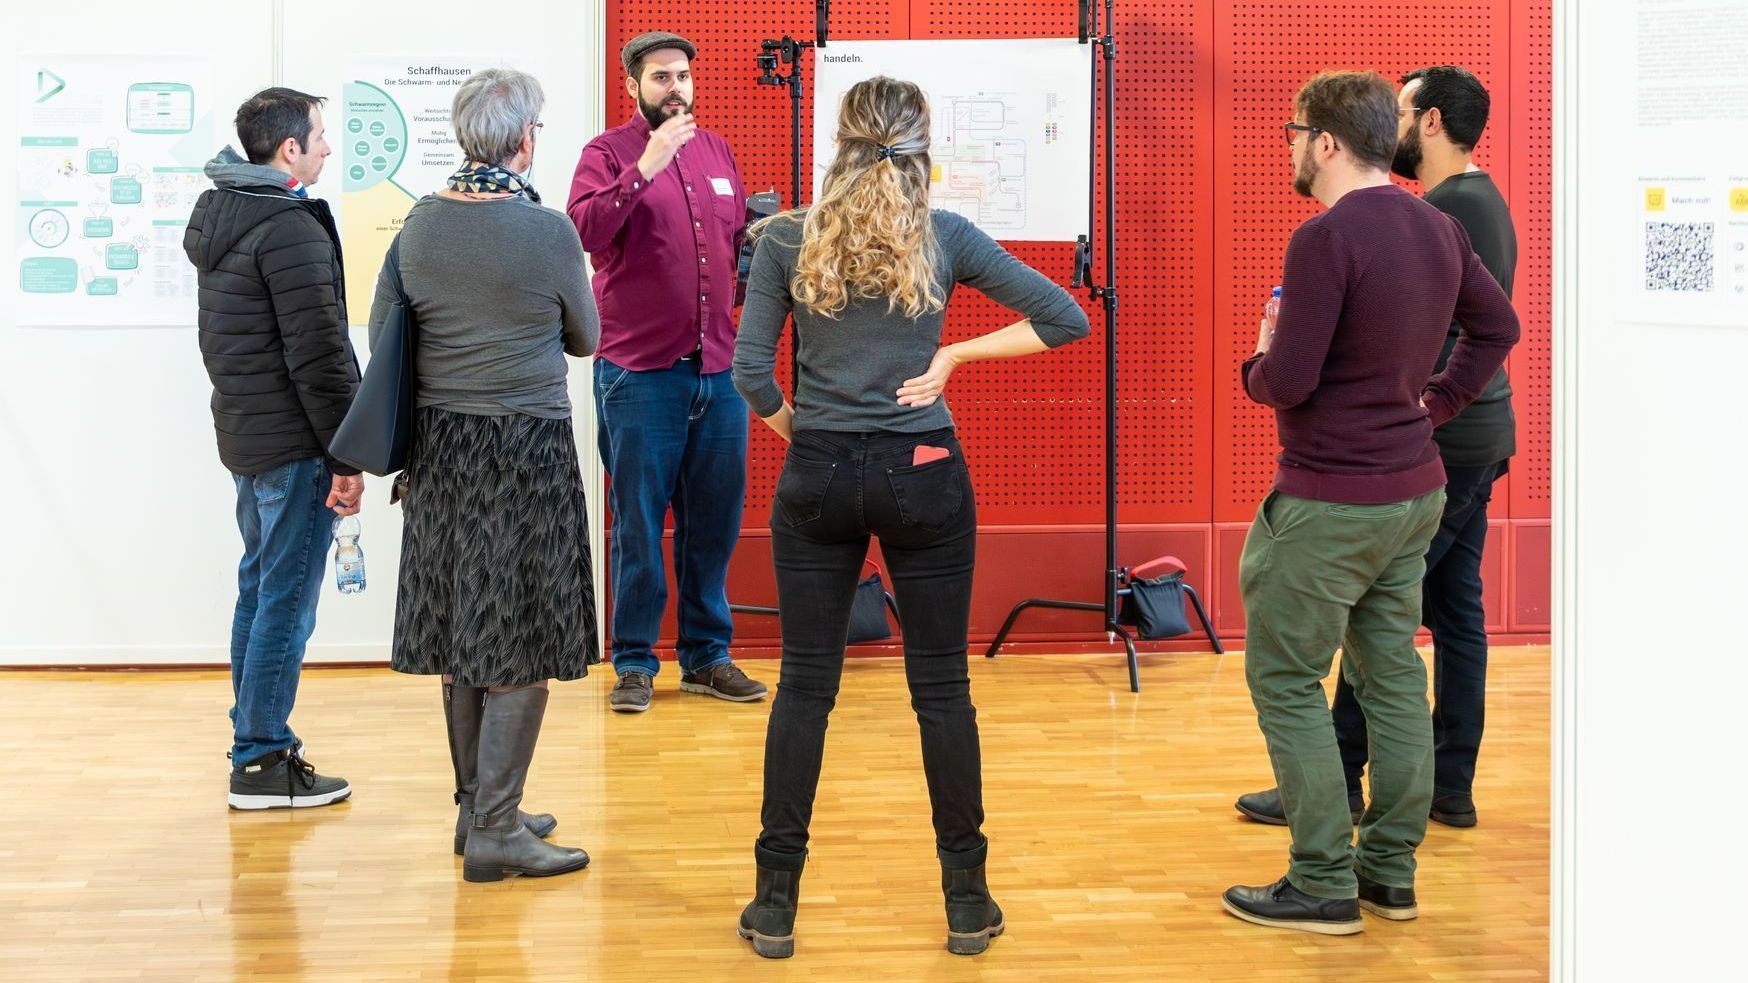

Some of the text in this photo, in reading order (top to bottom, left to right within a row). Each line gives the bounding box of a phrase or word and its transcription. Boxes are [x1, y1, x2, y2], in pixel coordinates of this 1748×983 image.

[824, 53, 863, 63] handeln.
[407, 66, 471, 75] Schaffhausen
[384, 79, 463, 87] Die Schwarm- und Ne
